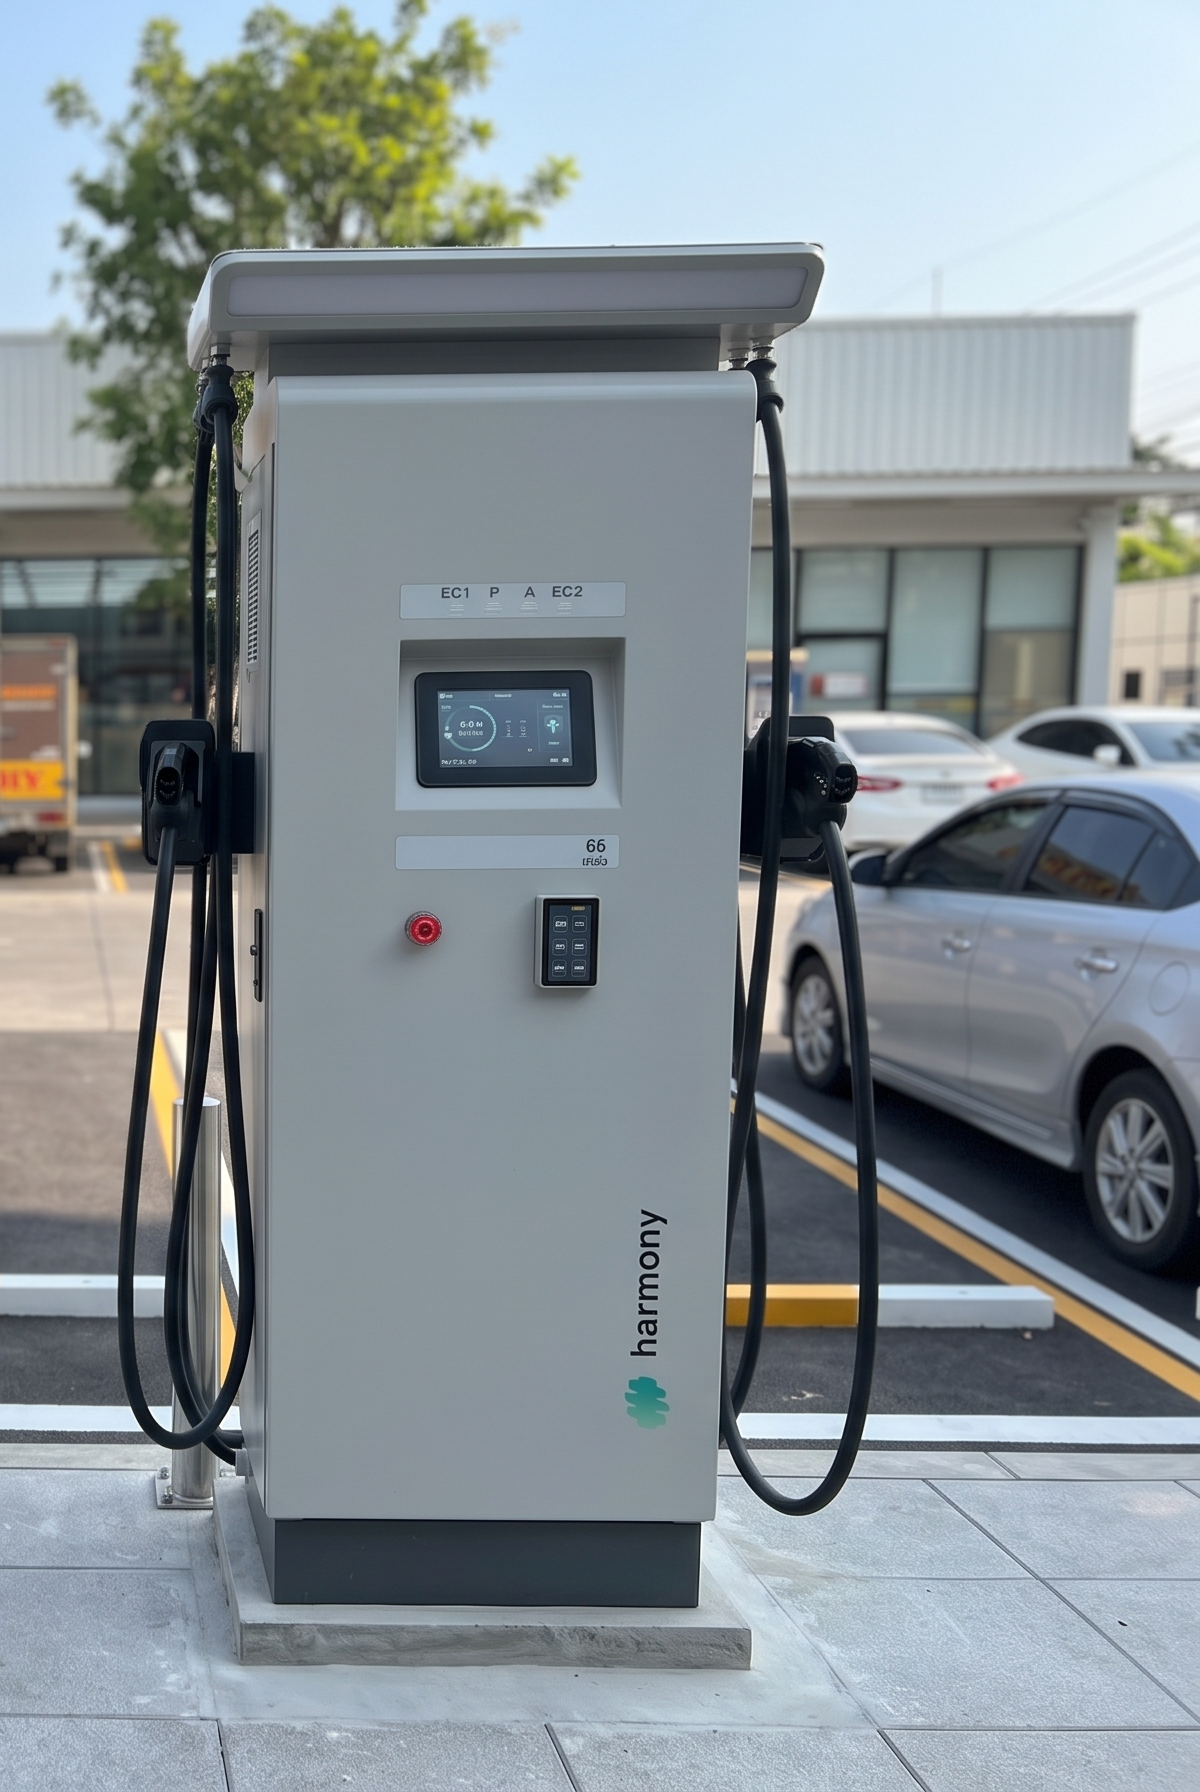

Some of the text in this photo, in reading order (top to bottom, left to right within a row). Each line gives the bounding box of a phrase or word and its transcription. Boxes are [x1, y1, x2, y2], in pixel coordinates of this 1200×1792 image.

[441, 586, 583, 599] EC1 P A EC2
[586, 838, 606, 853] 66
[630, 1208, 668, 1357] harmony
